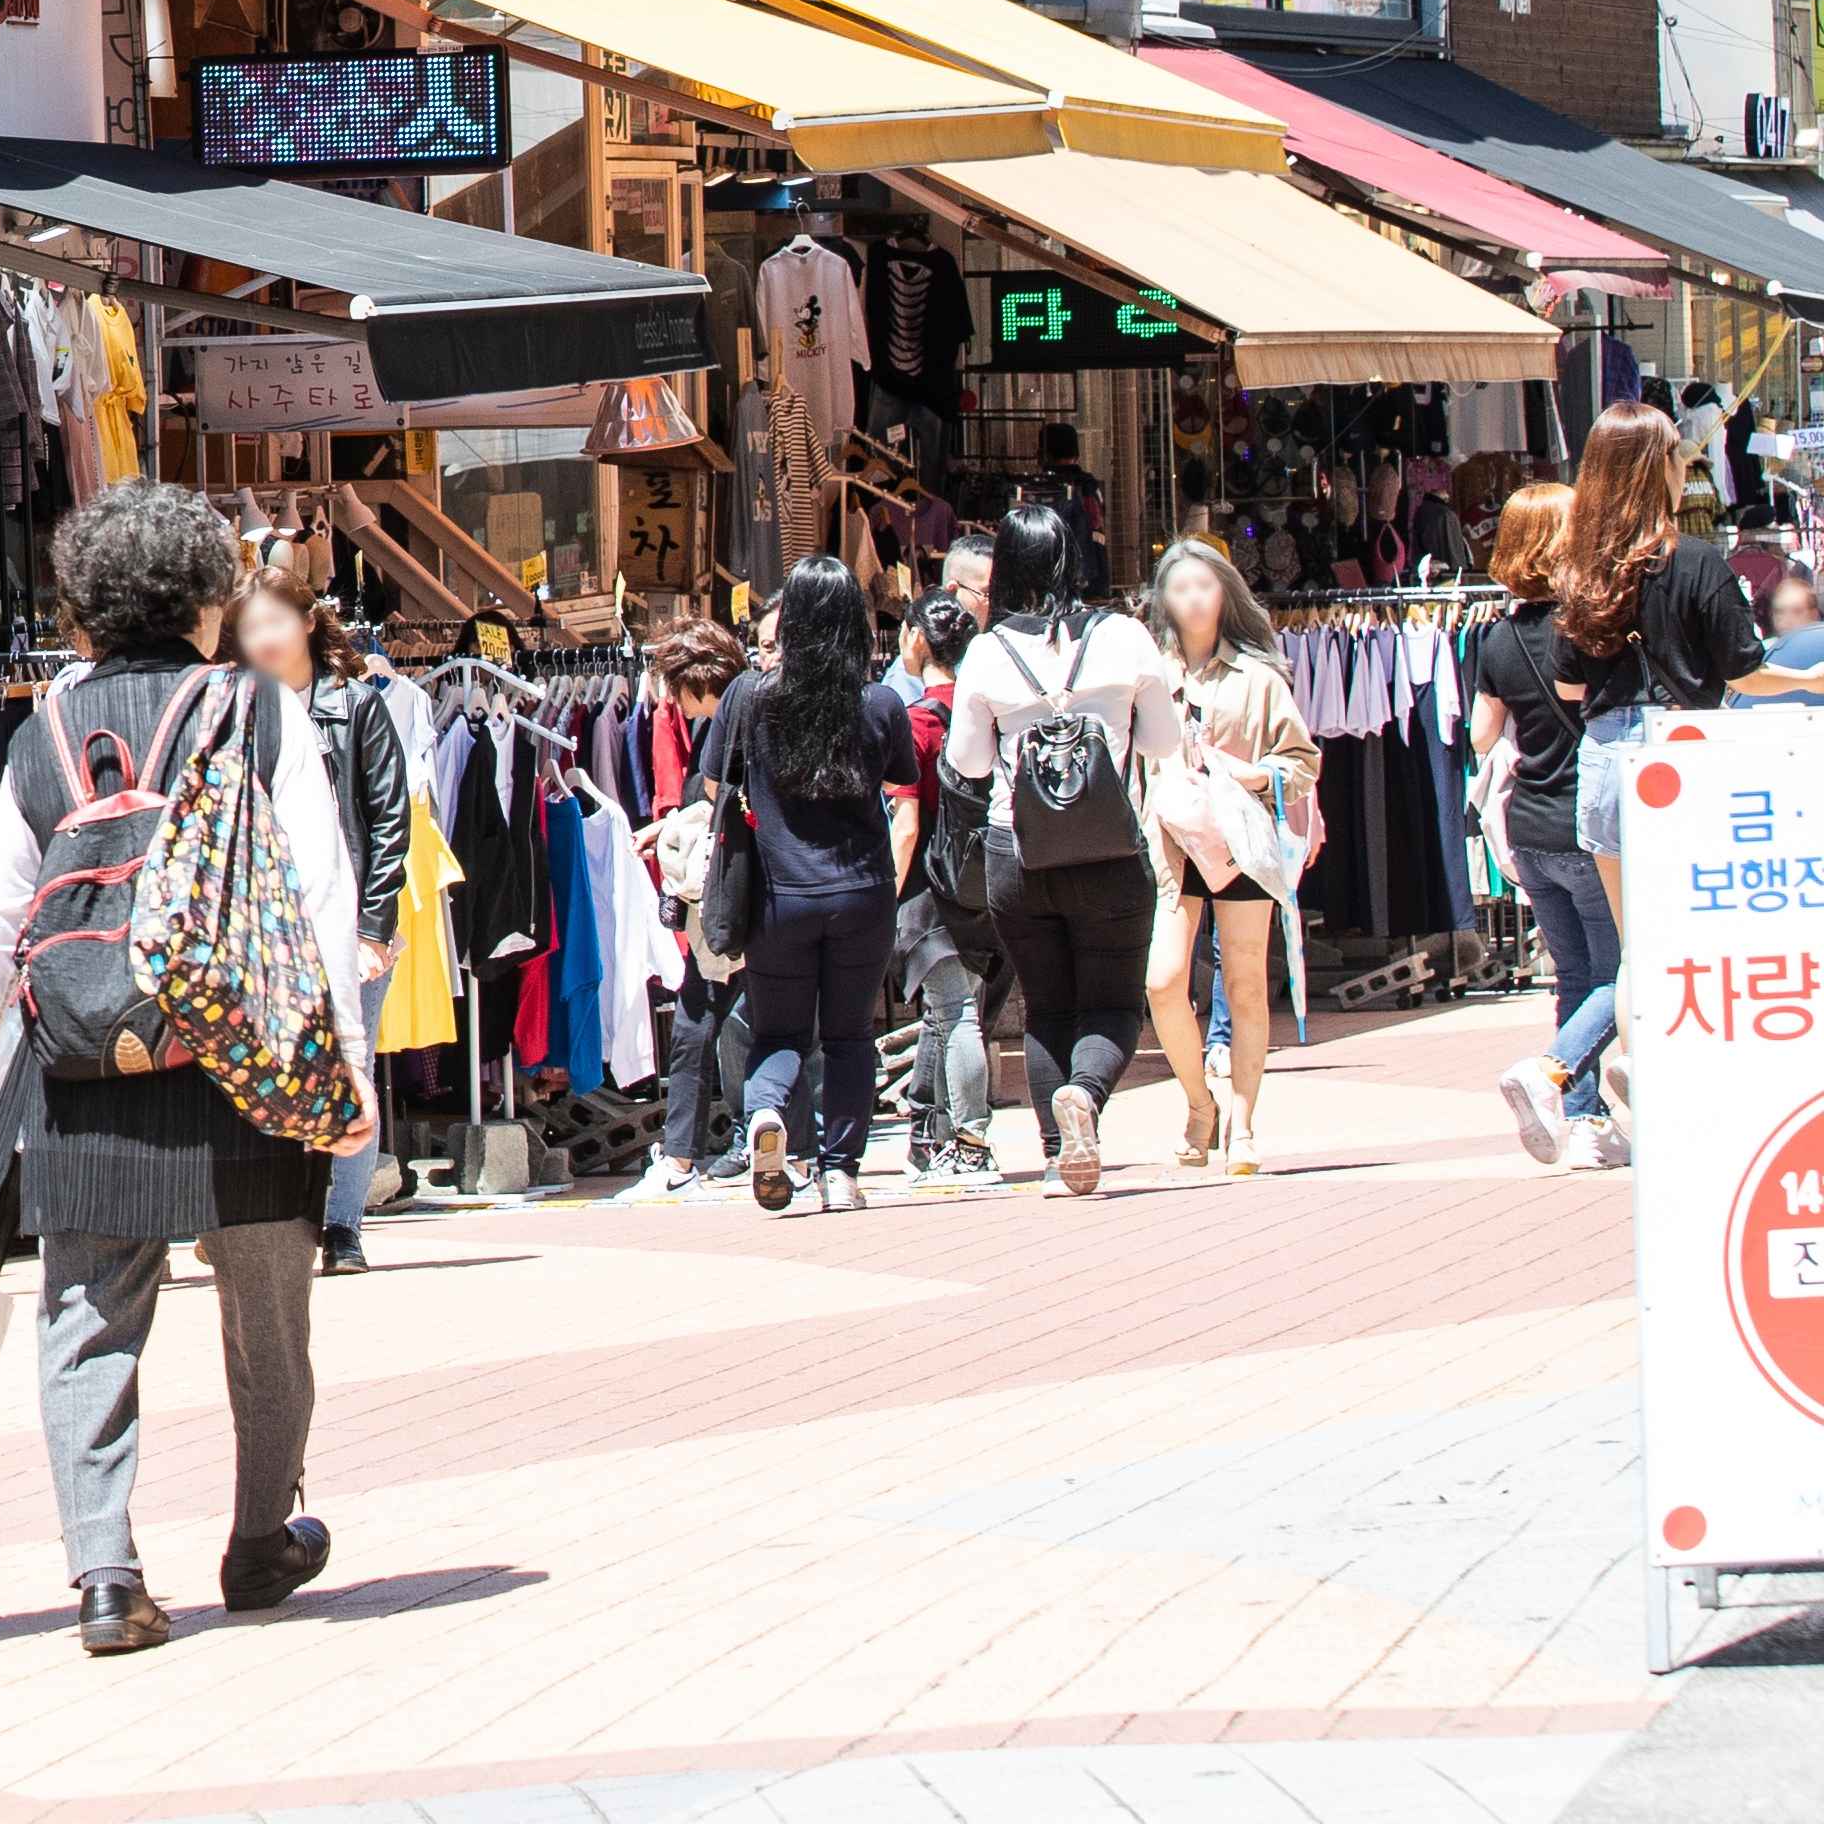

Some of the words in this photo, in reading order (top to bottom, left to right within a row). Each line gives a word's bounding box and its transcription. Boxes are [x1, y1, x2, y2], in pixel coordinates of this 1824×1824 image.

[224, 354, 270, 376] 가지
[1729, 790, 1774, 842] 금
[1665, 951, 1821, 1042] 차량
